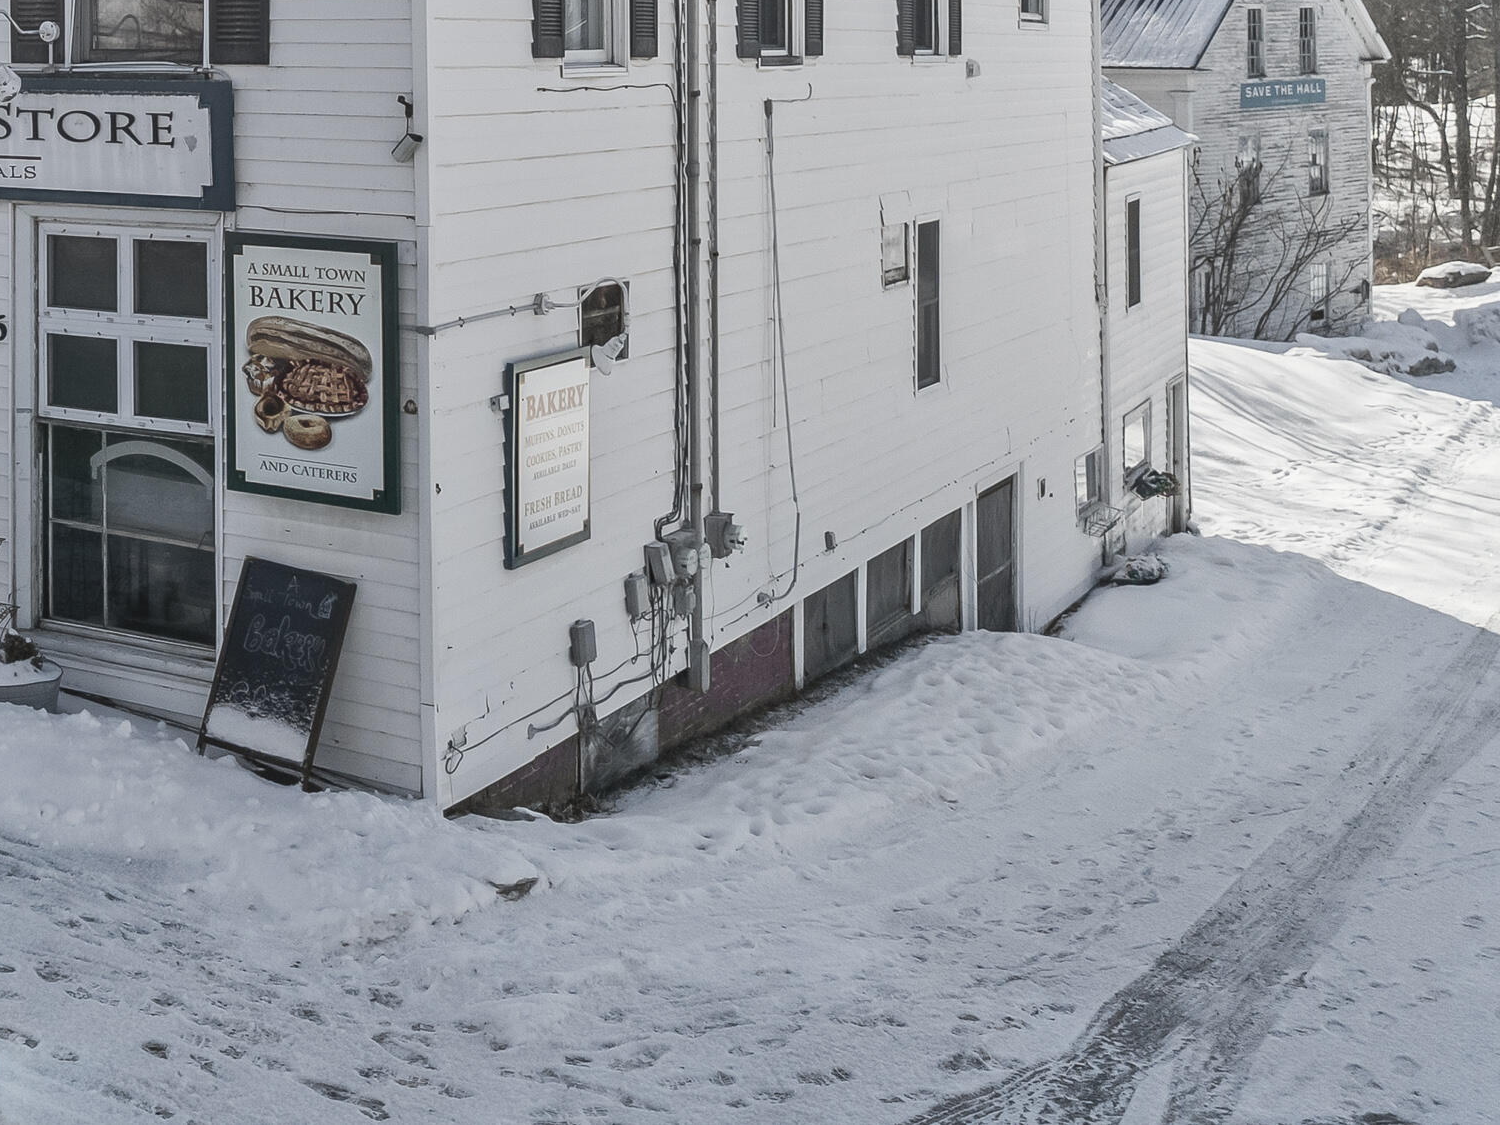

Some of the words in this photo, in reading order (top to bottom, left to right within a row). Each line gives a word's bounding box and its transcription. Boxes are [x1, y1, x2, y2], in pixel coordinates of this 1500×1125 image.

[1245, 85, 1271, 98] SAVE
[1274, 84, 1293, 96] THE
[1296, 82, 1321, 94] HALL
[247, 262, 258, 275] A
[262, 263, 309, 278] SMALL
[315, 266, 366, 283] TOWN
[248, 285, 366, 316] BAKERY
[525, 383, 585, 422] BAKERY
[259, 460, 289, 473] AND
[292, 464, 358, 484] CATERERS
[524, 495, 552, 517] FRESH
[554, 483, 583, 506] BREAD
[286, 573, 301, 594] A
